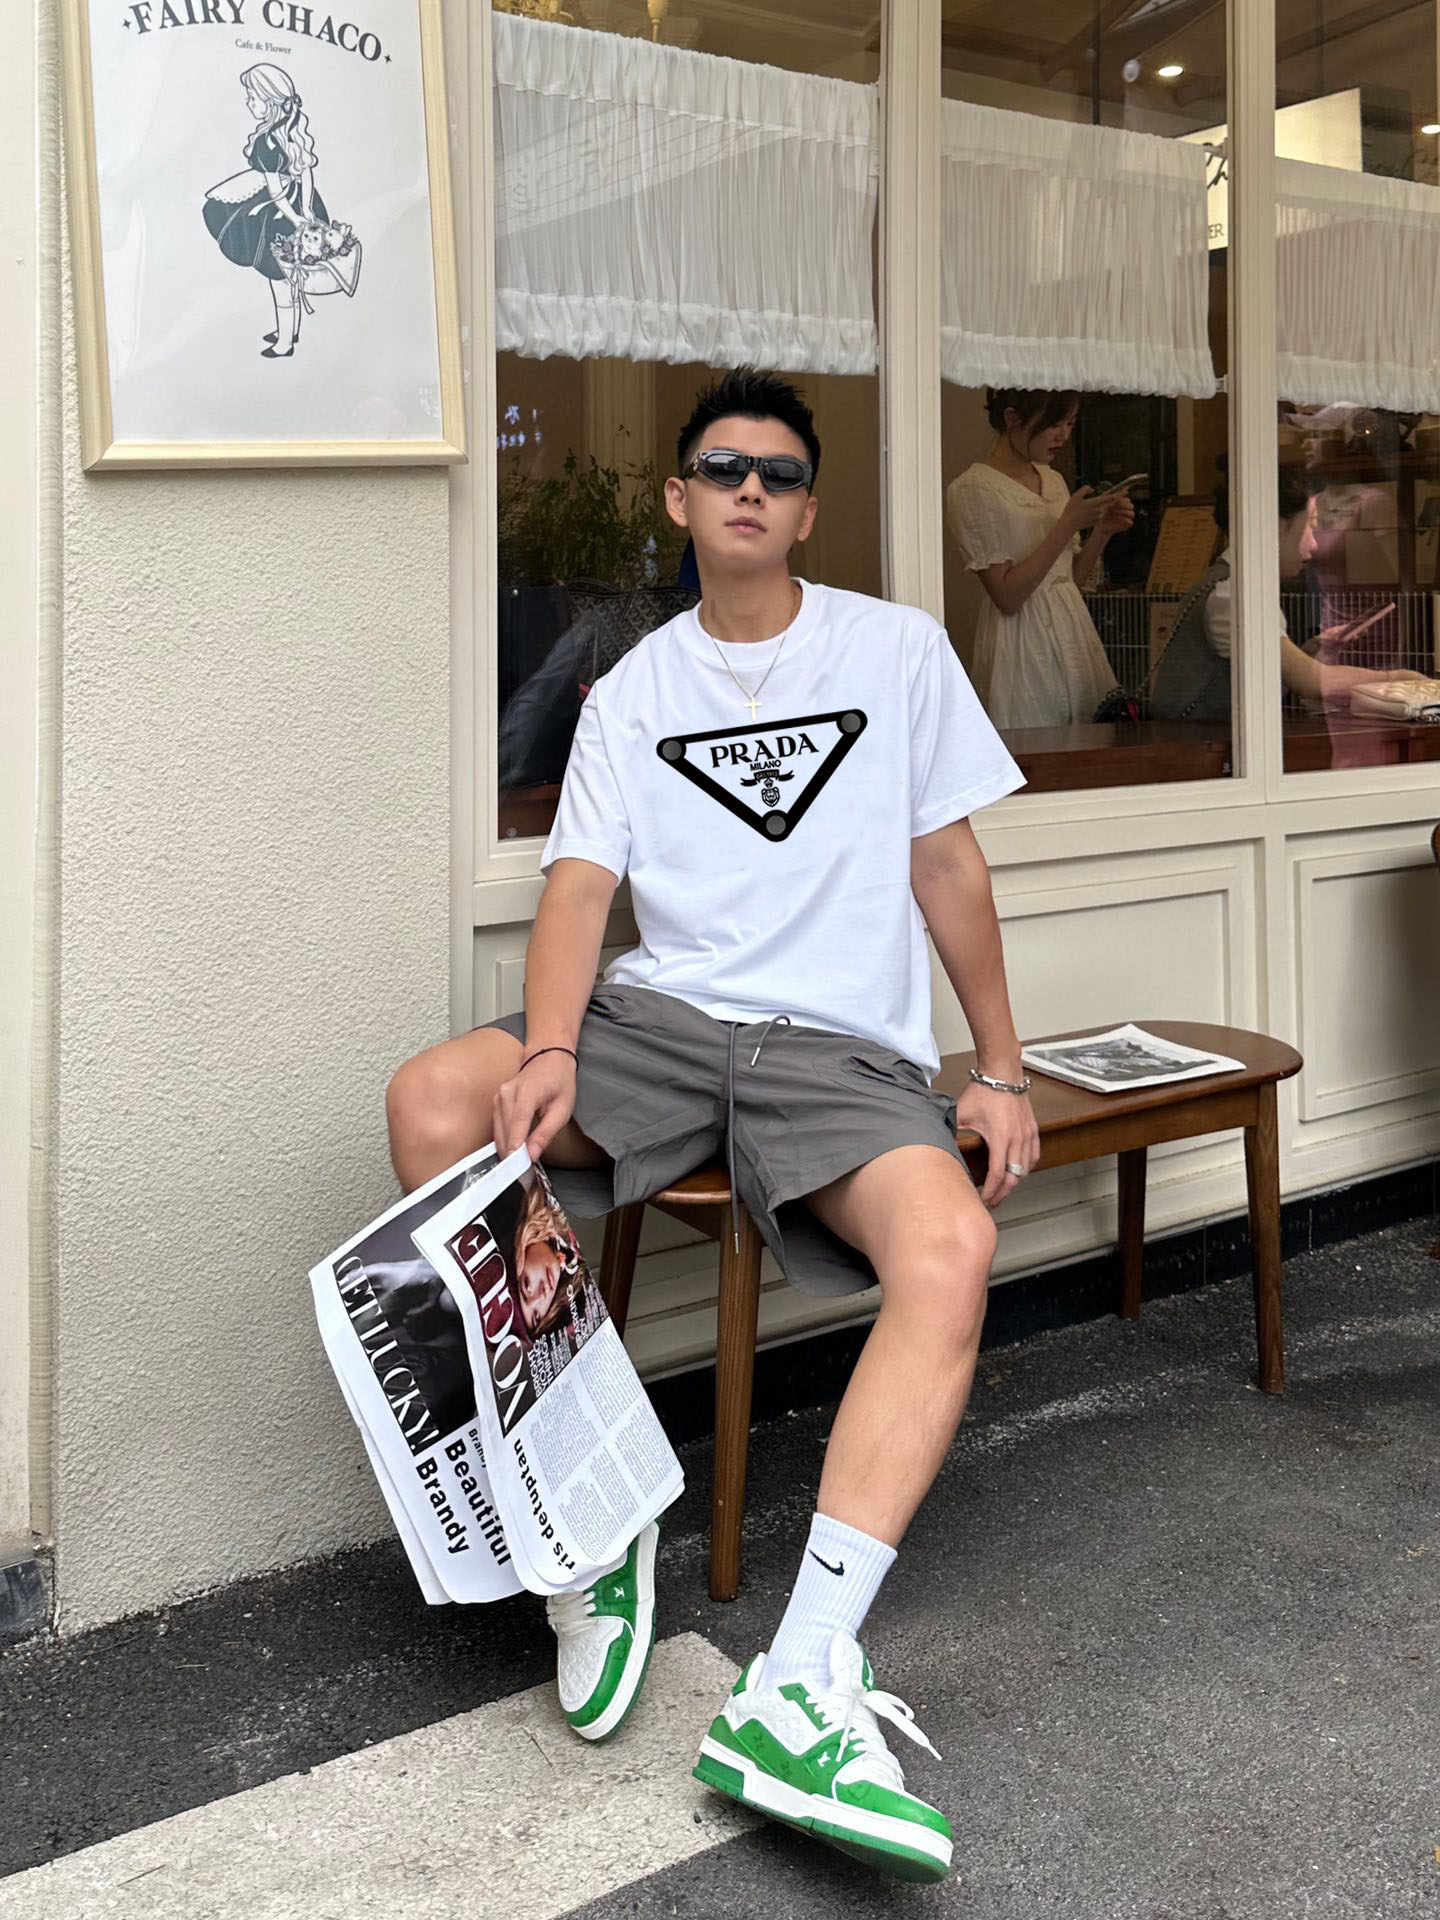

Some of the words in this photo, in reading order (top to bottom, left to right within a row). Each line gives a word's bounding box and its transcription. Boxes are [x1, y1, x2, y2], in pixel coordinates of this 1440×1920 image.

[129, 0, 245, 34] FAIRY
[262, 0, 382, 61] CHACO
[255, 42, 263, 51] &
[709, 733, 820, 768] PRADA
[750, 759, 782, 771] MILANO
[336, 1256, 383, 1319] GET
[450, 1215, 529, 1433] VOGUE
[359, 1321, 440, 1450] LUCKY!
[527, 1350, 542, 1398] BRIGHT
[533, 1339, 548, 1391] YOUNG
[541, 1334, 554, 1385] THINGS
[415, 1456, 470, 1554] Brandy
[444, 1438, 511, 1566] Beautiful
[514, 1439, 554, 1539] detuptan
[553, 1542, 576, 1575] ris
